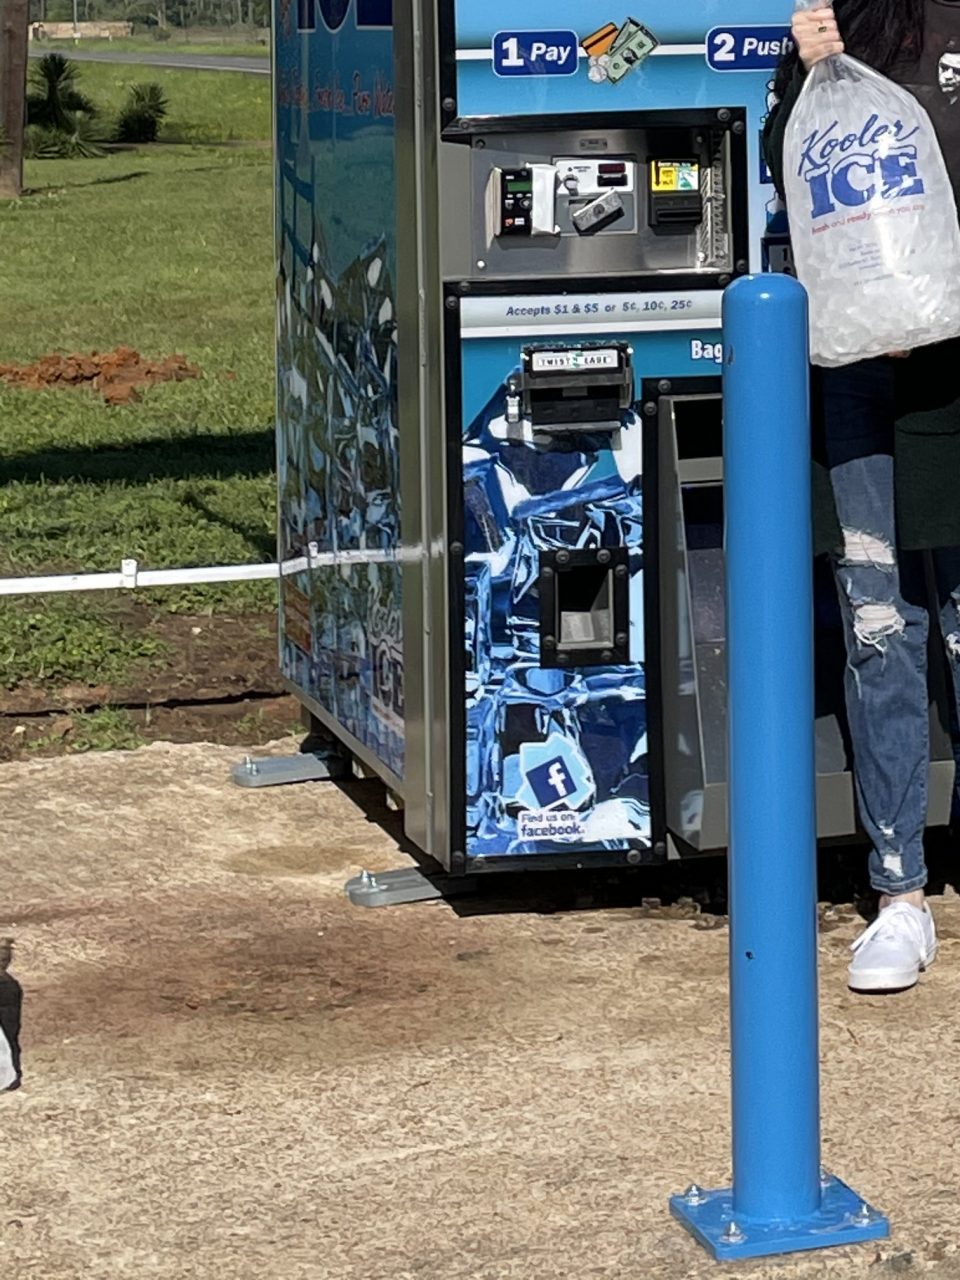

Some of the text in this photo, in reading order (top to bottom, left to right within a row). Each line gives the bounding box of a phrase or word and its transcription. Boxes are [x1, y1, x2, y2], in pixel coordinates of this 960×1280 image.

[502, 37, 571, 67] 1 Pay
[712, 33, 794, 62] 2 Push
[797, 113, 920, 177] Kooler
[803, 144, 925, 219] ICE
[506, 304, 551, 318] Accepts
[554, 303, 569, 315] $1
[572, 304, 581, 314] &
[584, 302, 599, 314] $5
[604, 302, 616, 313] or
[521, 822, 581, 837] facebook
[545, 813, 558, 822] us
